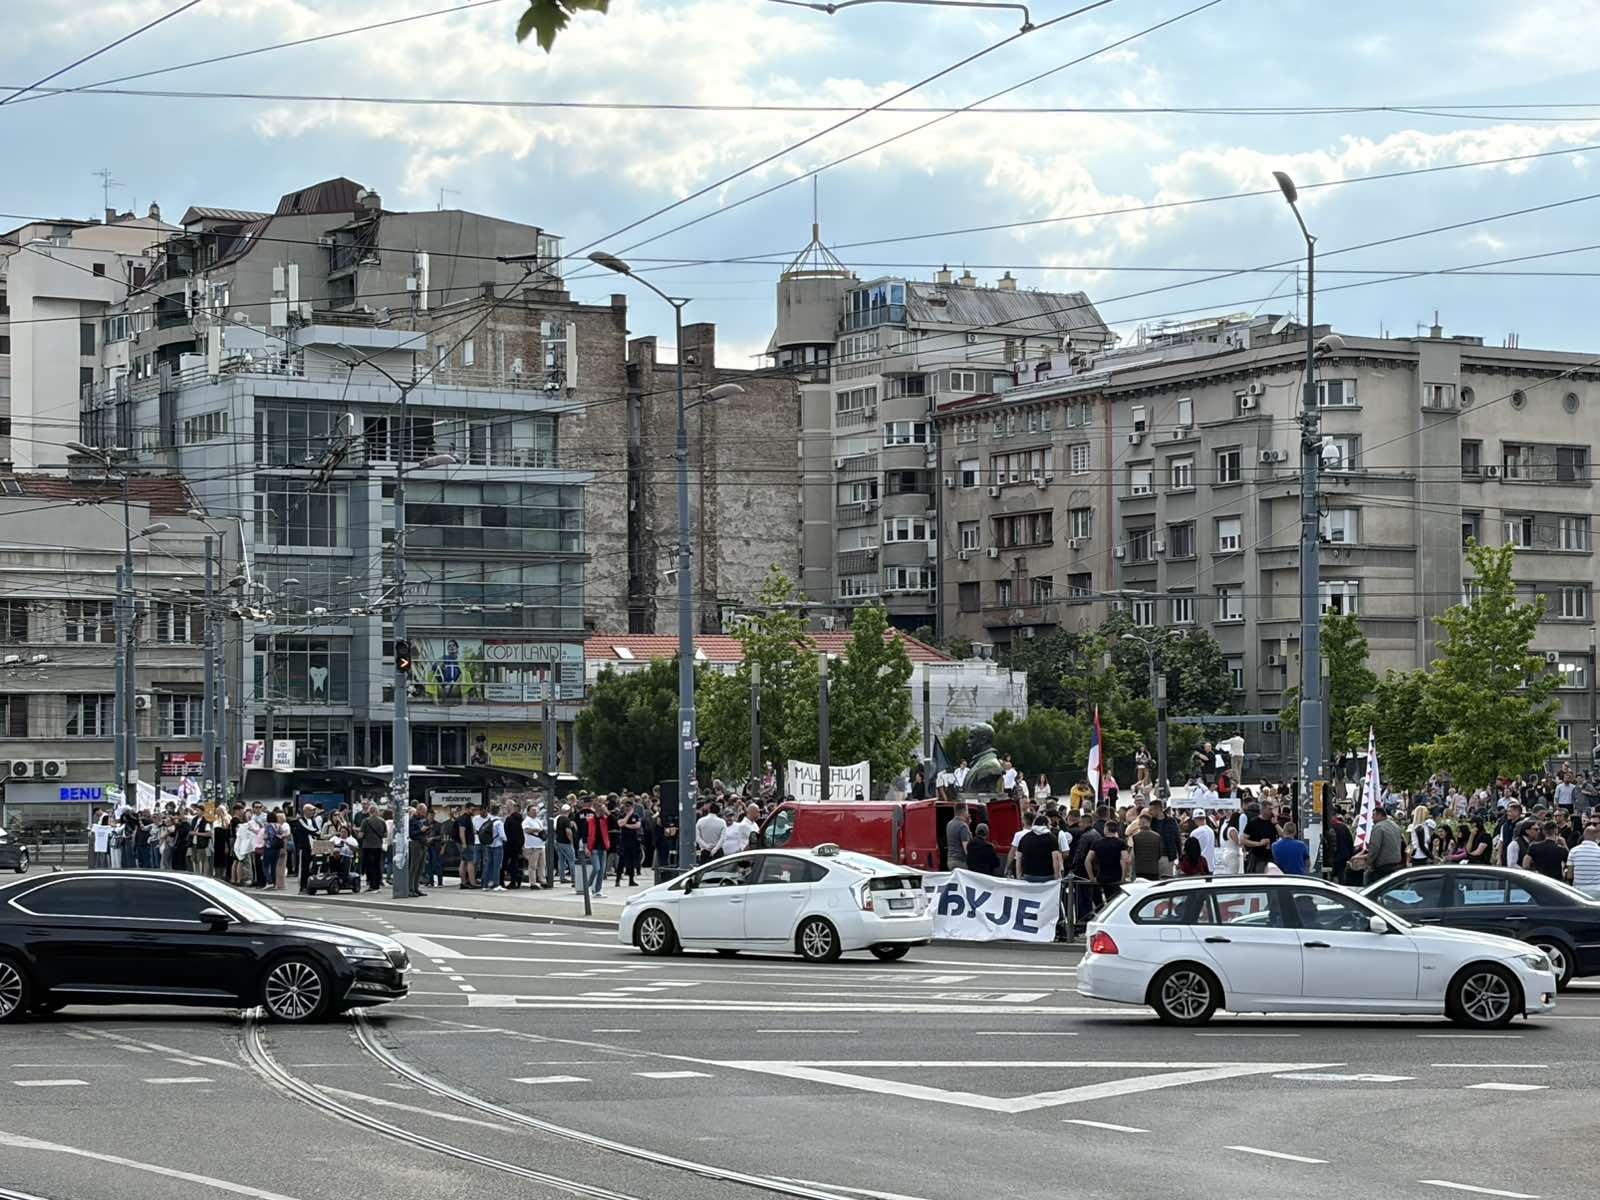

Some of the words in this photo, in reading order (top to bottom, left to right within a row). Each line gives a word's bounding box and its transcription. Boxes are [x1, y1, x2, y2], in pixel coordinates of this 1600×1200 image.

[486, 645, 520, 660] COPY
[524, 645, 559, 660] LAND
[795, 766, 861, 782] МАШНЦИ
[60, 787, 101, 800] BENU
